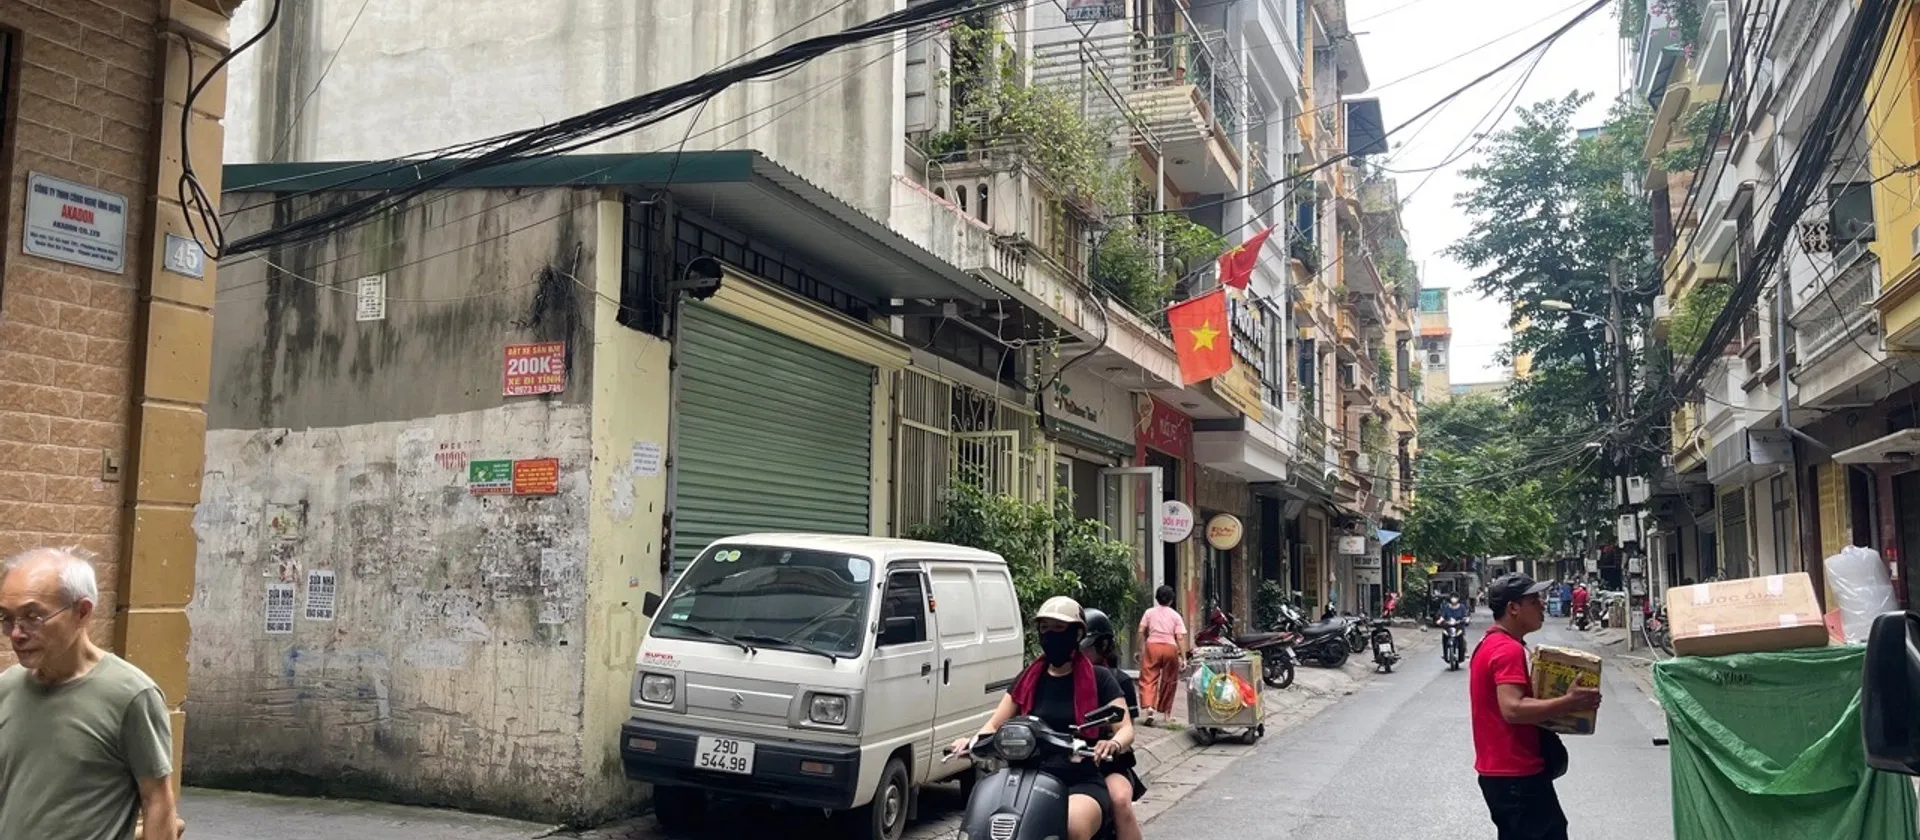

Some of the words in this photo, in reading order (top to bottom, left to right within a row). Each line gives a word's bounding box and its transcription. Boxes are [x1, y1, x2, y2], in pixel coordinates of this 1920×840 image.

[172, 245, 197, 270] 45
[507, 356, 551, 376] 200K
[508, 377, 520, 386] XE
[645, 652, 673, 660] SUPER
[713, 739, 738, 754] 29D
[701, 753, 746, 771] 544.98
